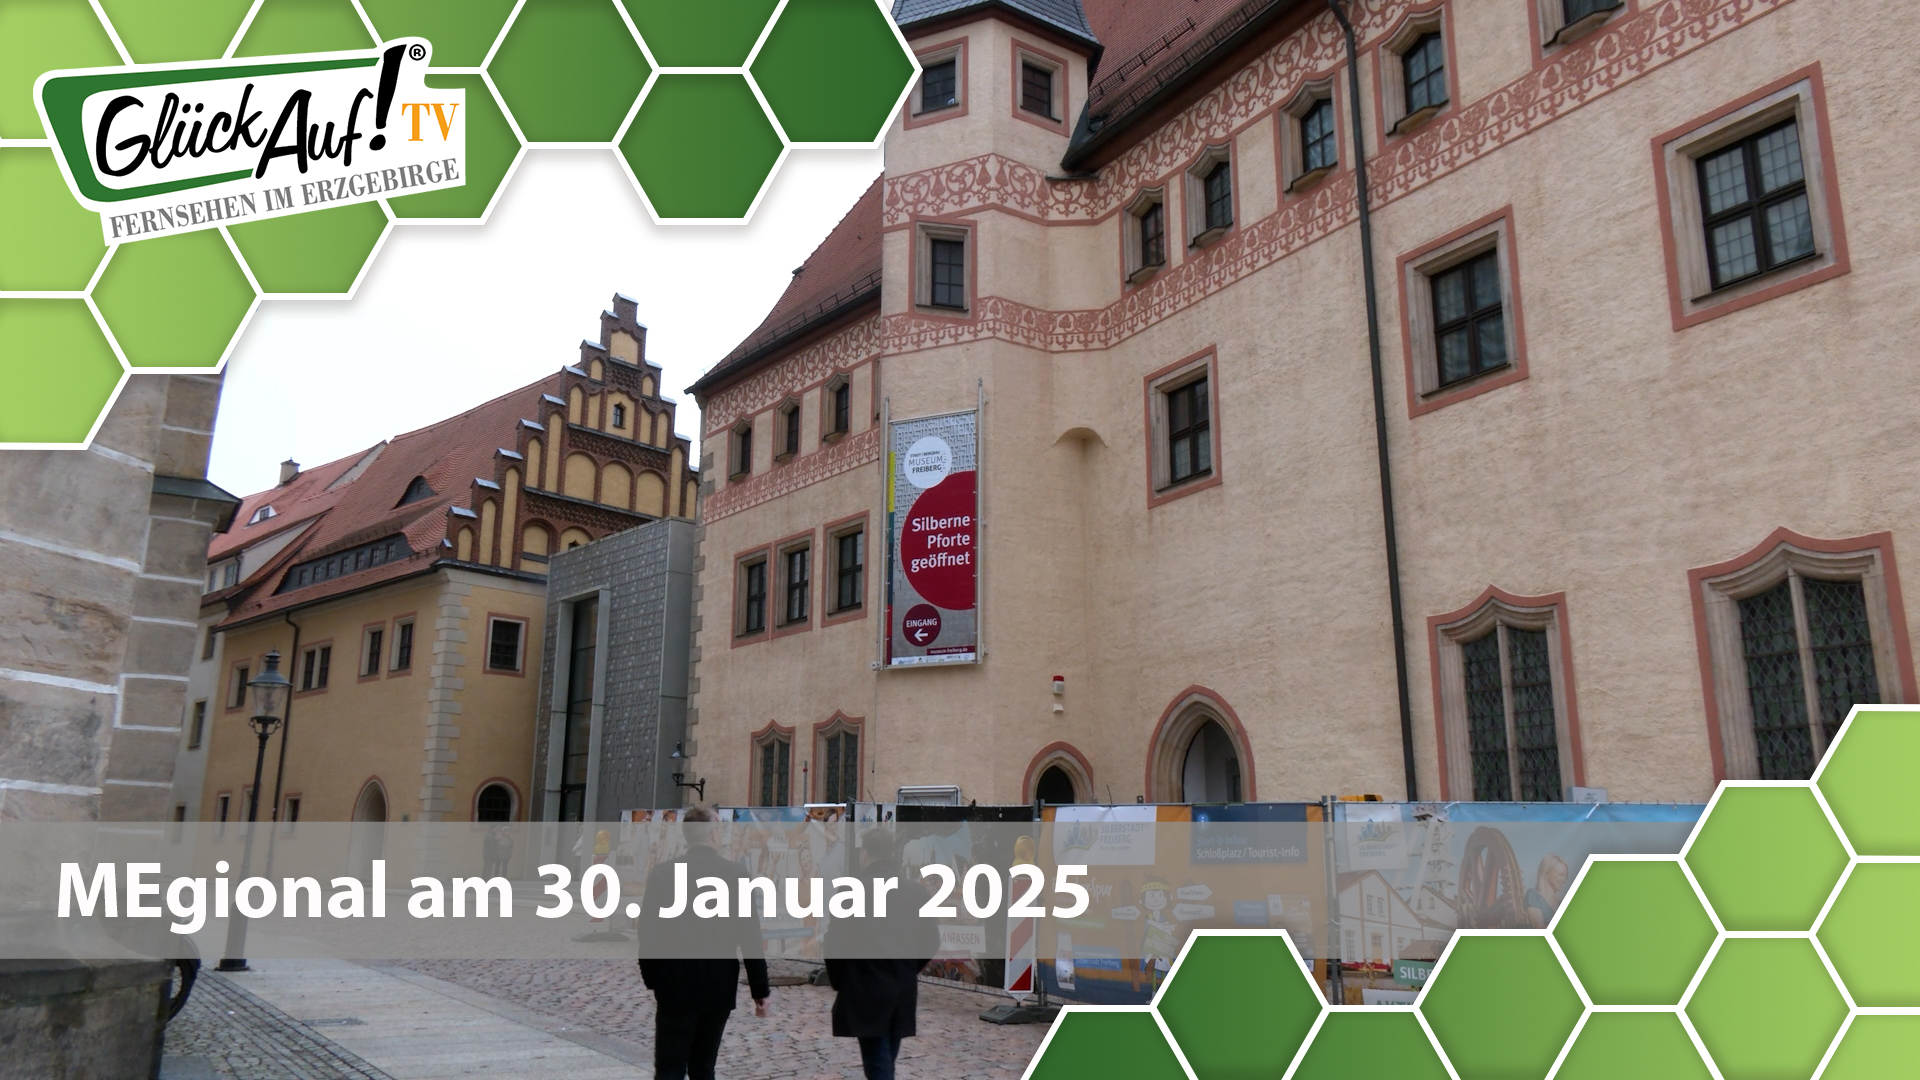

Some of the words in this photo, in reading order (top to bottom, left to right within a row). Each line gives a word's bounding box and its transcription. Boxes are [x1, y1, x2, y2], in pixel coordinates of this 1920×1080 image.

[909, 455, 943, 466] MUSEUM
[912, 463, 942, 474] FREIBERG
[911, 515, 971, 532] Silberne
[927, 533, 971, 549] Pforte
[911, 551, 971, 573] geöffnet
[906, 618, 938, 628] EINGANG
[1101, 823, 1145, 834] SILBERSTADT
[1100, 834, 1132, 844] FREIBERG
[1197, 835, 1215, 846] Start
[1216, 835, 1223, 845] &
[1225, 834, 1249, 845] Infos:
[1247, 846, 1300, 858] Tourist-Info
[941, 932, 980, 945] ANFASSEN
